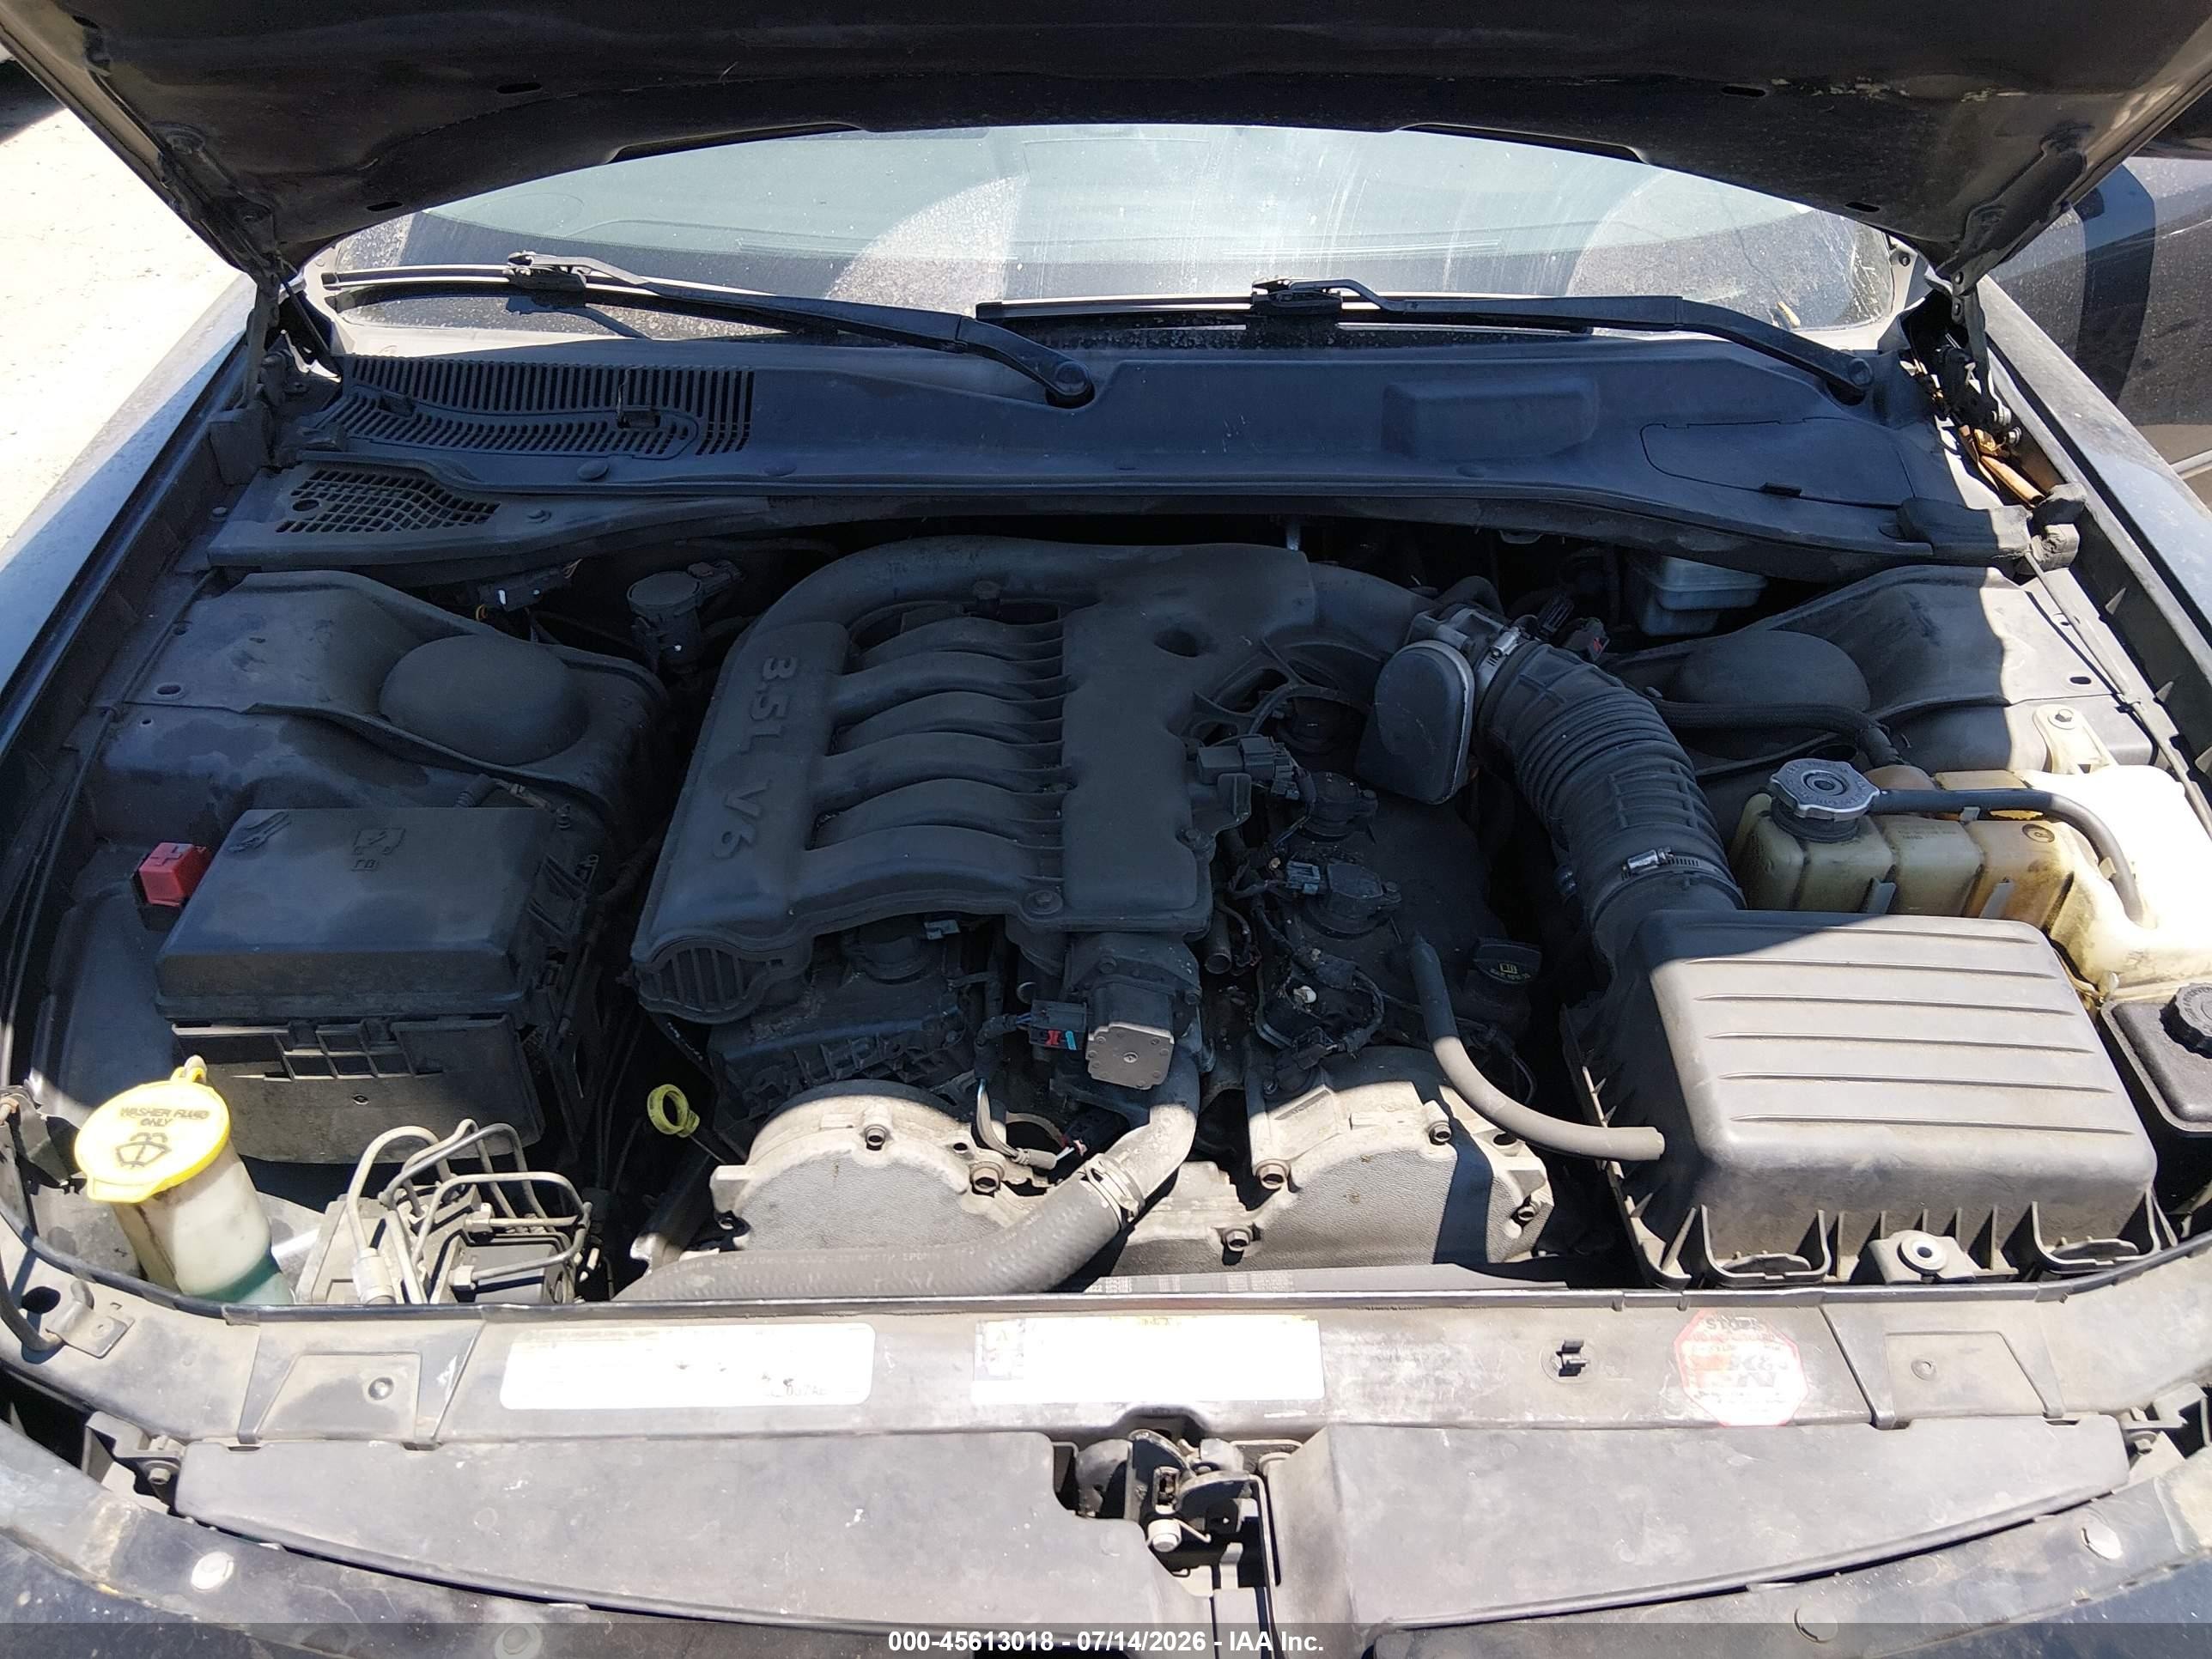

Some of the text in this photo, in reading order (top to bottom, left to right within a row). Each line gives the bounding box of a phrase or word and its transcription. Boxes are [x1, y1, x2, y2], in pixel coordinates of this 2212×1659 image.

[713, 657, 798, 860] 3.5L V6
[120, 1108, 172, 1118] WASHER
[140, 1117, 173, 1127] ONLY
